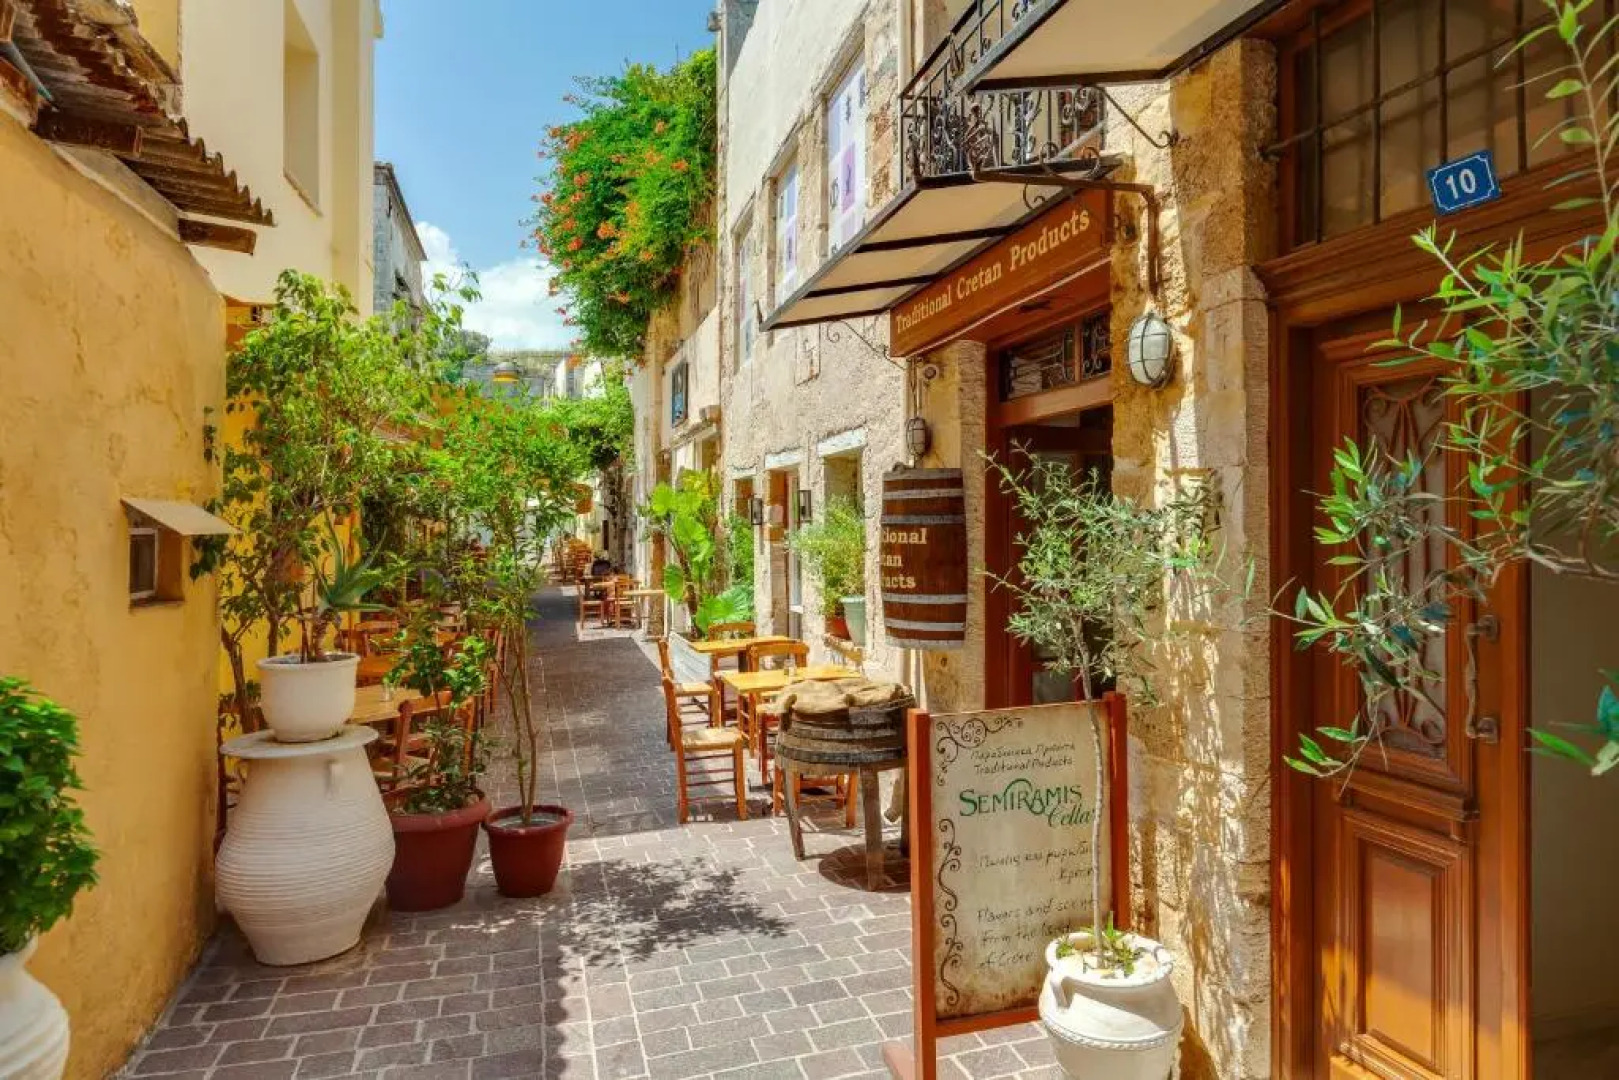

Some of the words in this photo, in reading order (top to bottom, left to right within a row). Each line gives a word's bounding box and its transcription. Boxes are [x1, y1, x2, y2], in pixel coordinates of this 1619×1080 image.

[1445, 169, 1476, 199] 10
[896, 284, 953, 334] Traditional
[956, 261, 1002, 299] Cretan
[1009, 209, 1091, 272] Products
[881, 527, 928, 545] ional
[1025, 898, 1054, 916] and
